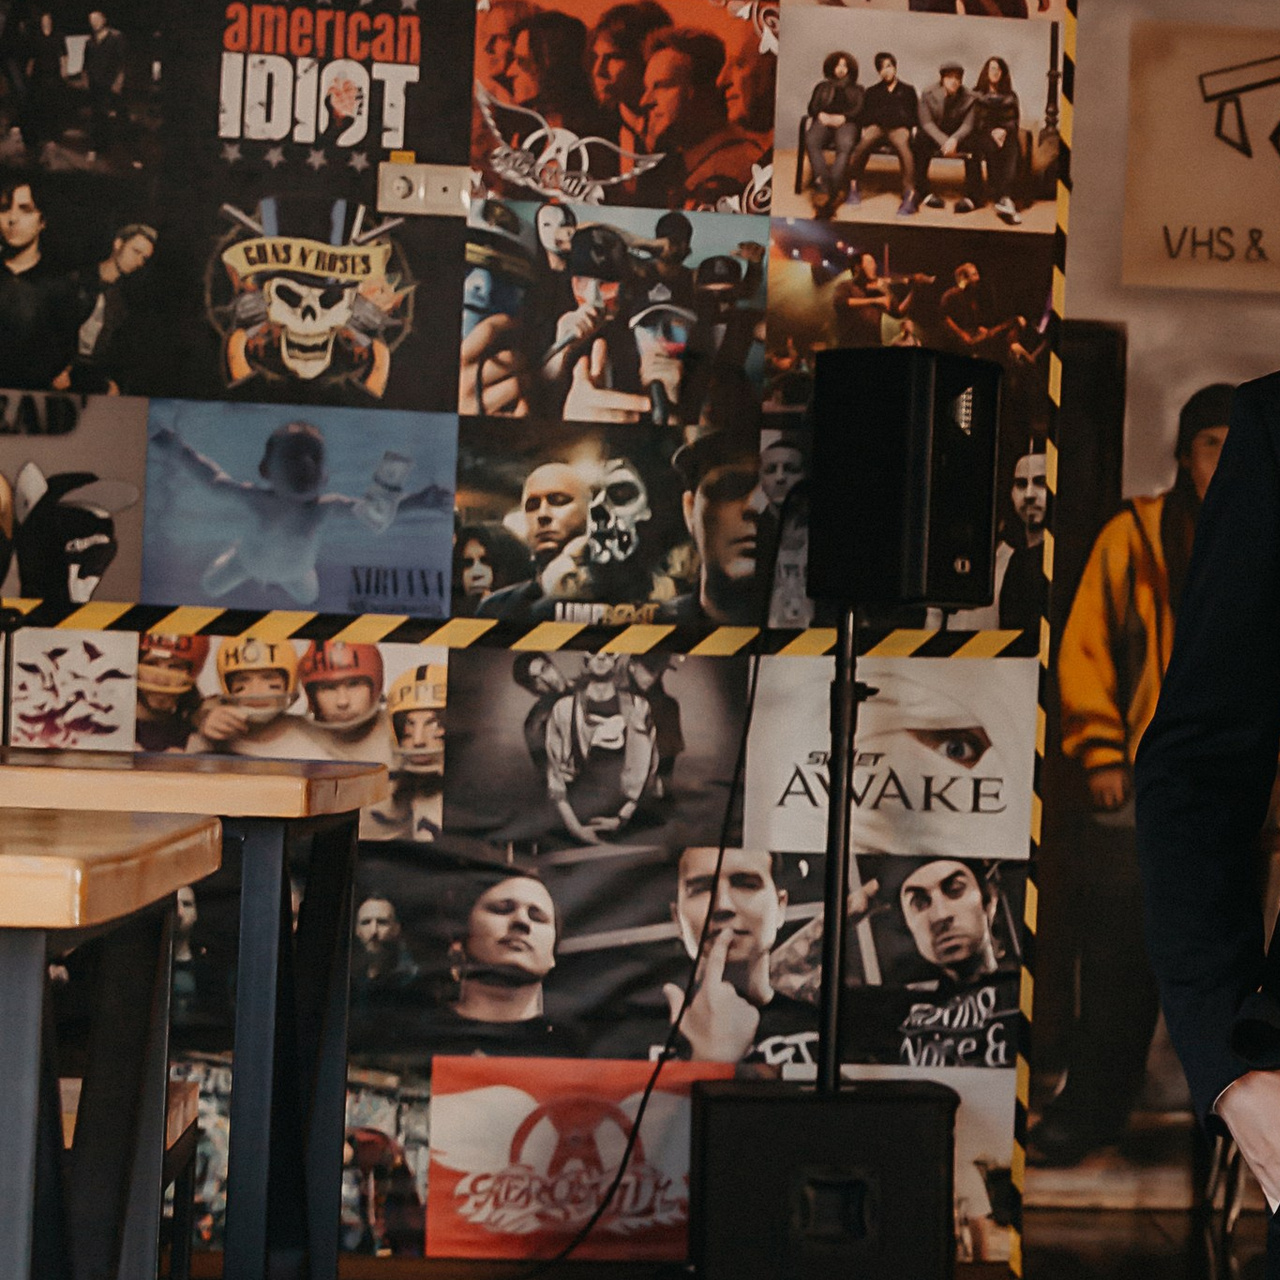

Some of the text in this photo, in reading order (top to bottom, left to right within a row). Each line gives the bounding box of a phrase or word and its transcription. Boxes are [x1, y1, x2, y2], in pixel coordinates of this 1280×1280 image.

[222, 1, 421, 64] american
[218, 51, 420, 149] IDIOT
[243, 243, 292, 266] GUNS
[1162, 225, 1236, 263] VHS
[1245, 229, 1269, 262] &
